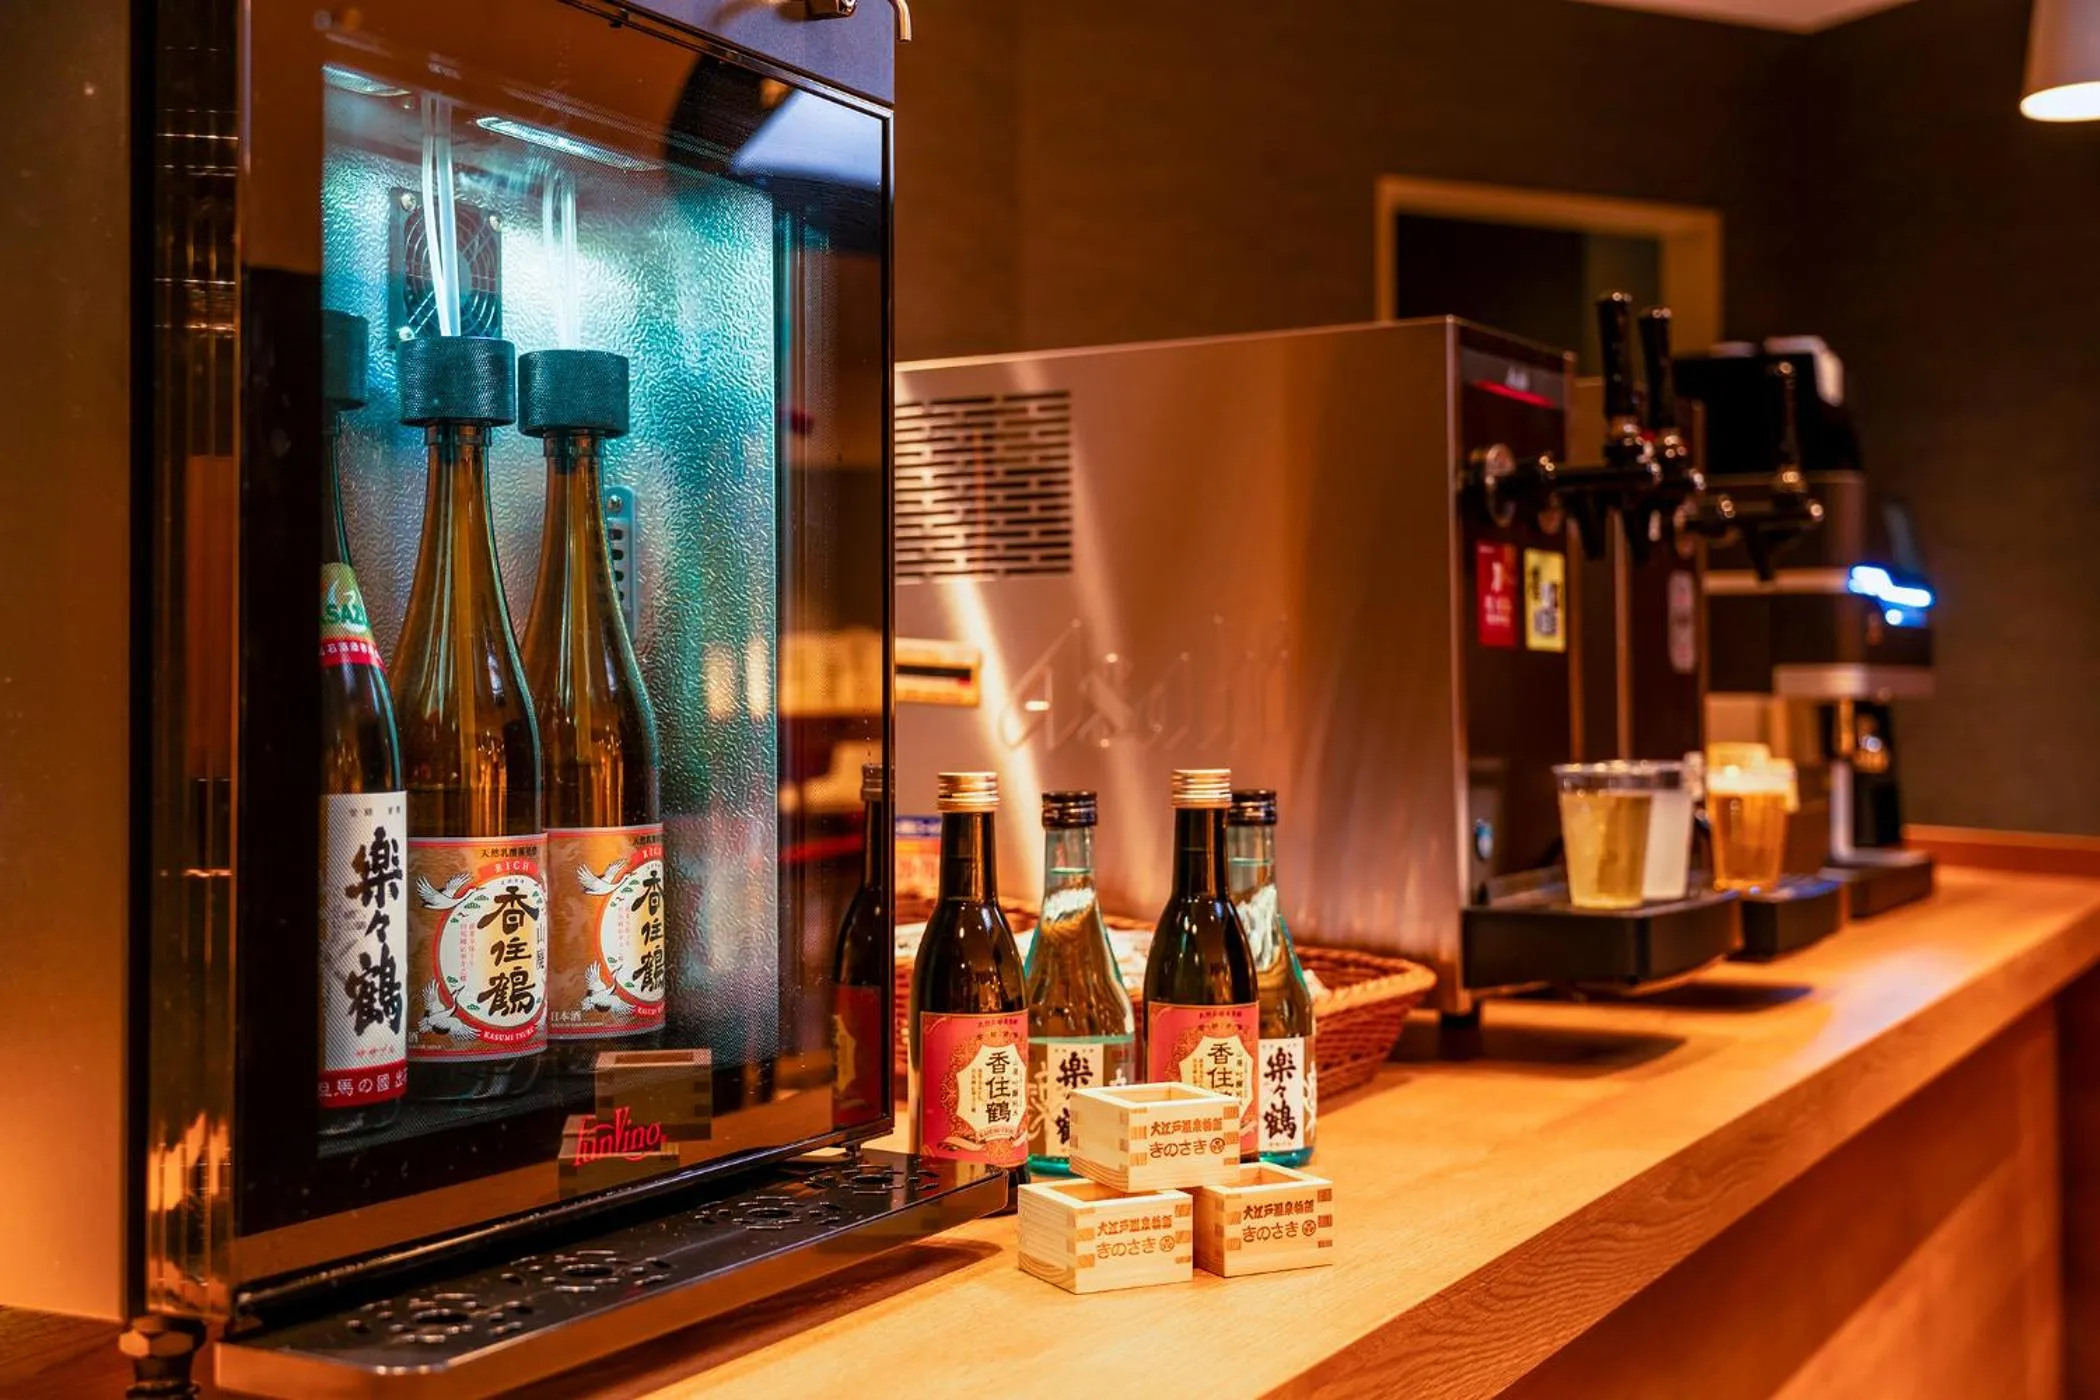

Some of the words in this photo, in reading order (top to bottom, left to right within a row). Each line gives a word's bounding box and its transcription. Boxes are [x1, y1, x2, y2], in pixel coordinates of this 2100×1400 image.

[477, 886, 540, 1017] 香住鶴
[985, 1050, 1012, 1123] 香住鶴
[1206, 1042, 1234, 1096] 香住
[1149, 1139, 1207, 1158] きのさき
[1096, 1236, 1156, 1259] きのさき
[1242, 1221, 1299, 1242] きのさき
